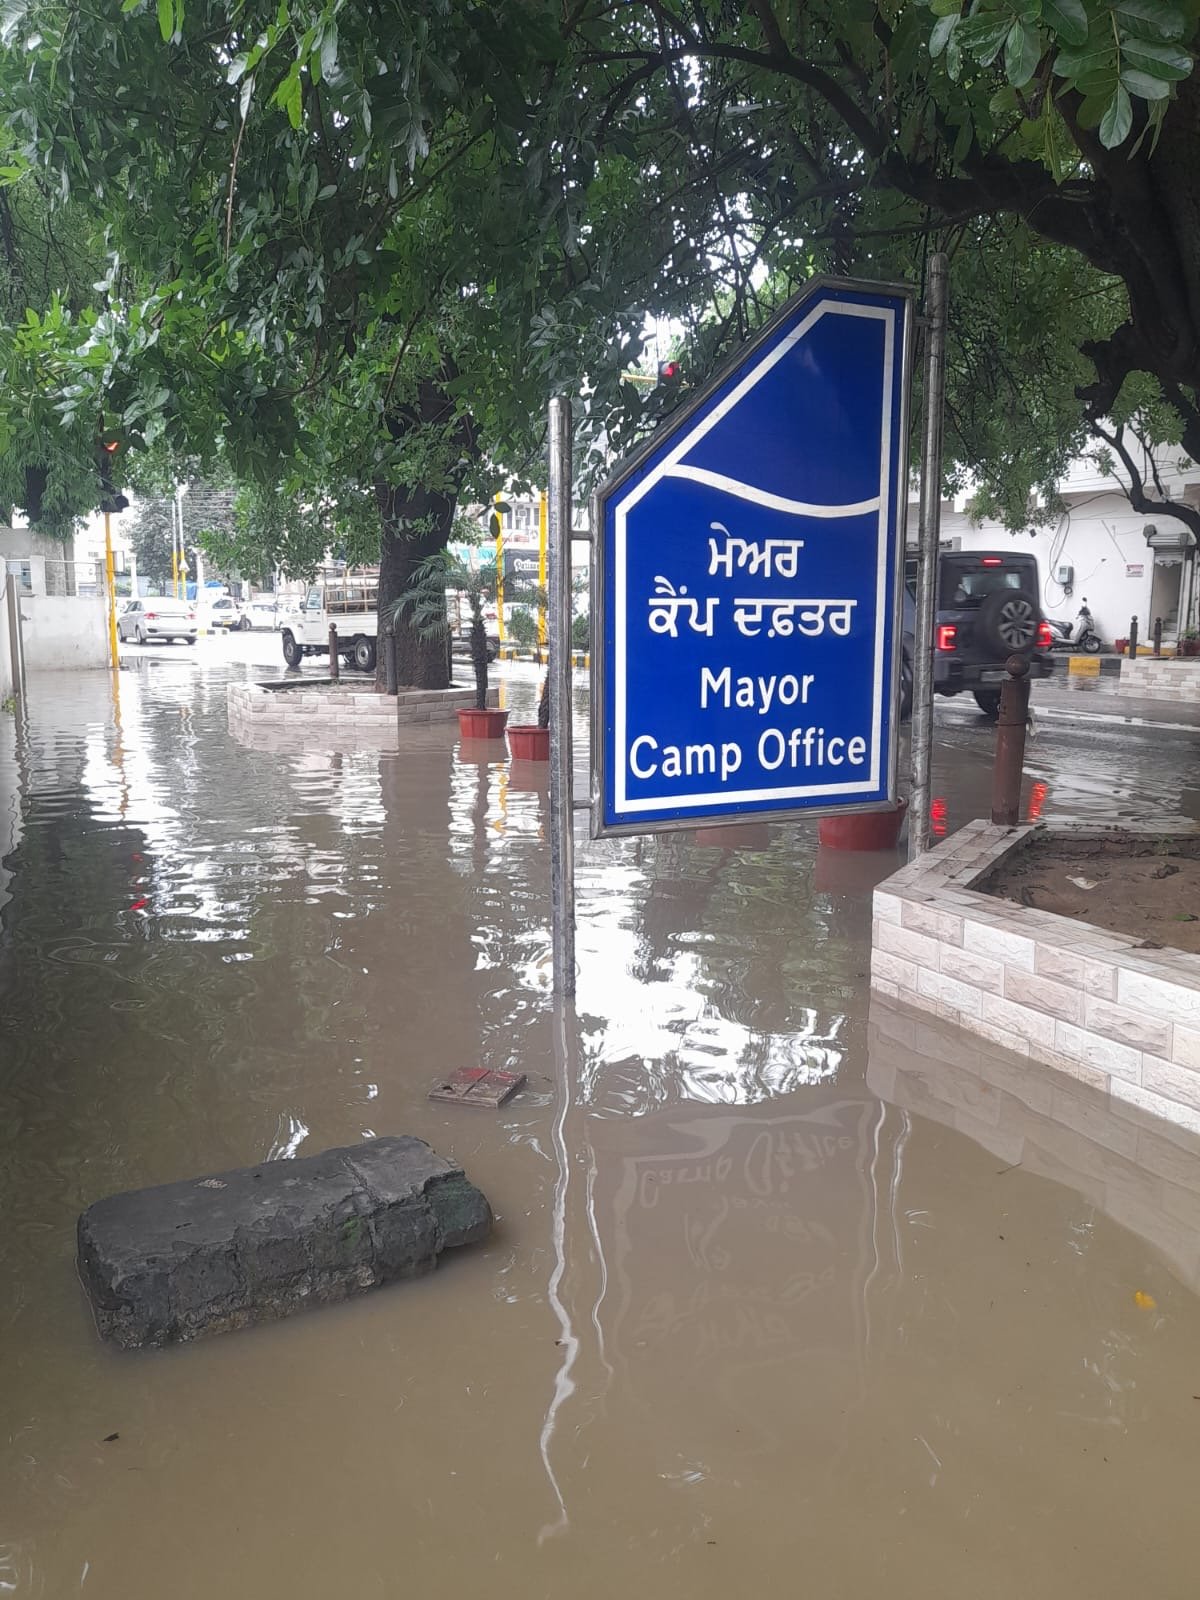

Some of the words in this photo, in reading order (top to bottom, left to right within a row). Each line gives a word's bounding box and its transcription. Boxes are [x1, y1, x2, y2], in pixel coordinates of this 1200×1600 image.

[708, 522, 805, 578] ਮੇਅਰ
[648, 575, 719, 638] ਕੈਂਪ
[700, 667, 815, 715] Mayor
[629, 734, 742, 781] Camp
[758, 727, 867, 771] Office
